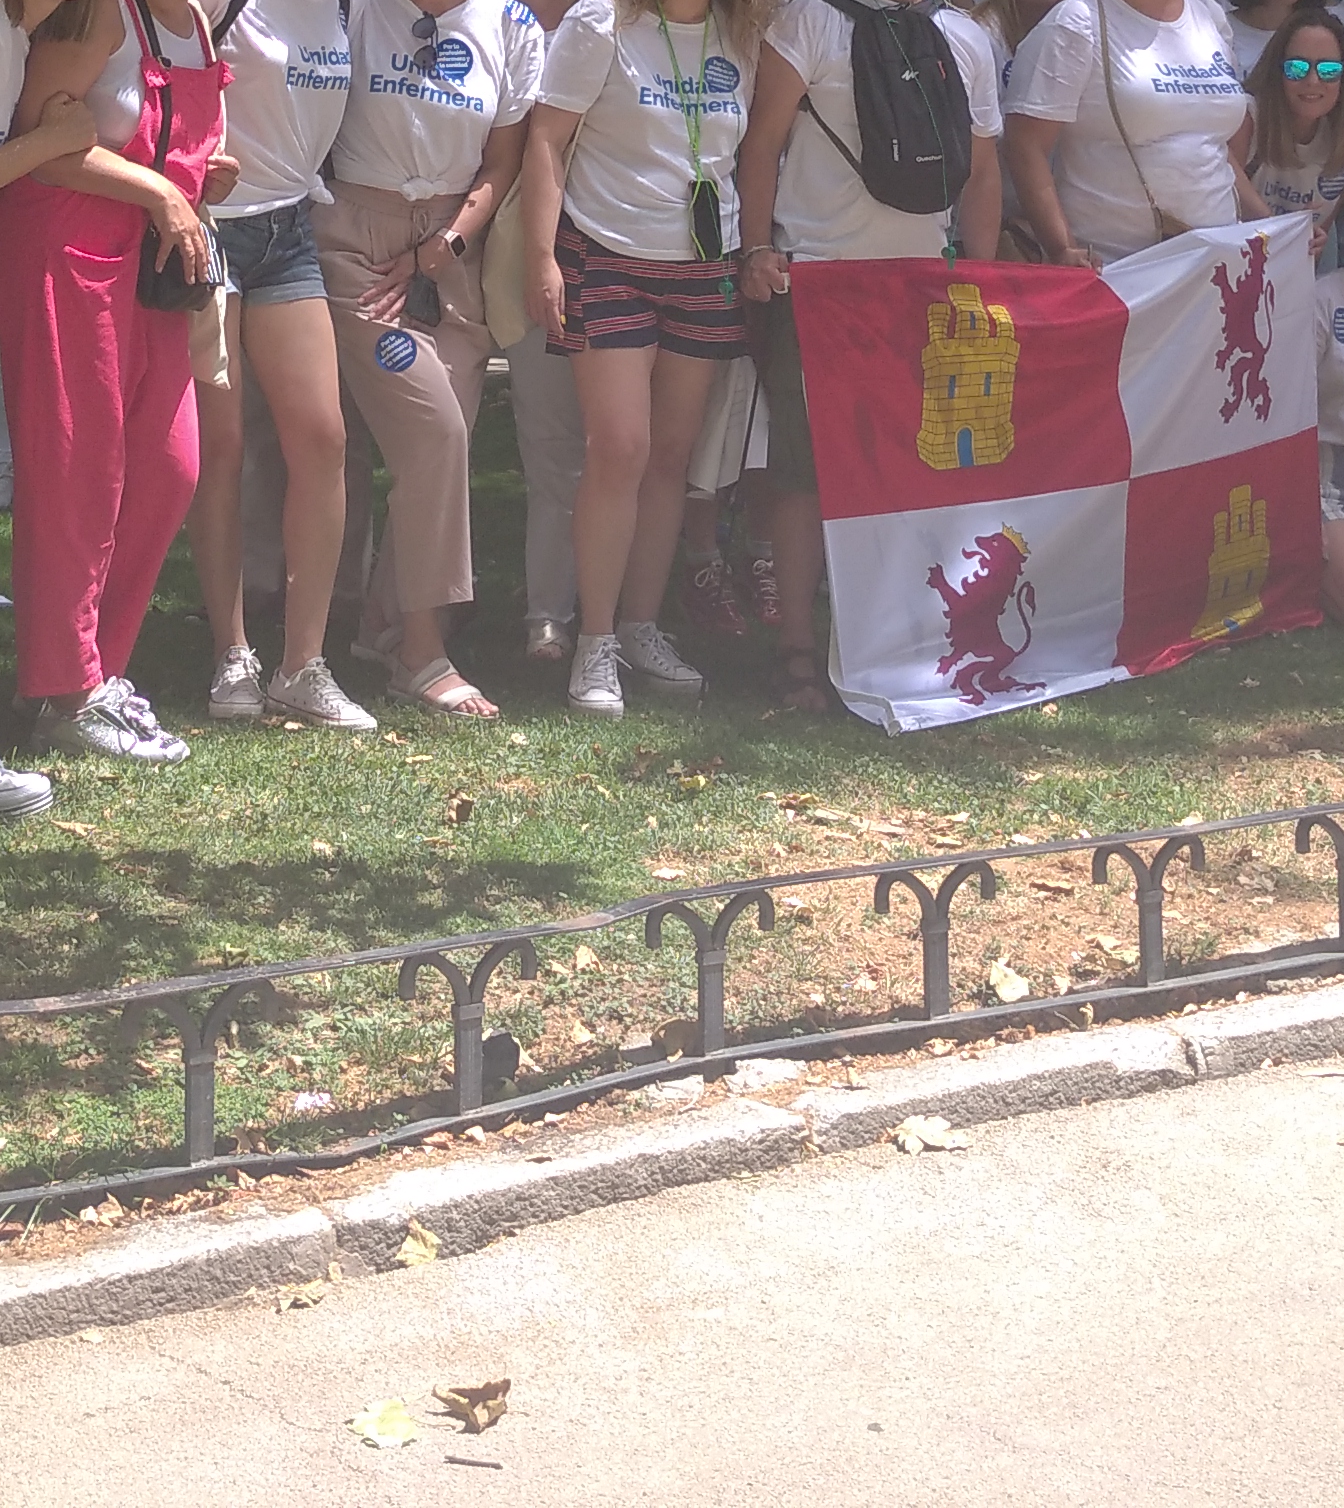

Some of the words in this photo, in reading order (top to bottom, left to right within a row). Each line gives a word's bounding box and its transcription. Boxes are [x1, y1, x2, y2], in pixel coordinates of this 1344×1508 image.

[298, 45, 350, 65] Unida
[287, 66, 350, 90] Enferm
[1155, 63, 1223, 78] Unidad
[370, 75, 483, 113] Enfermera
